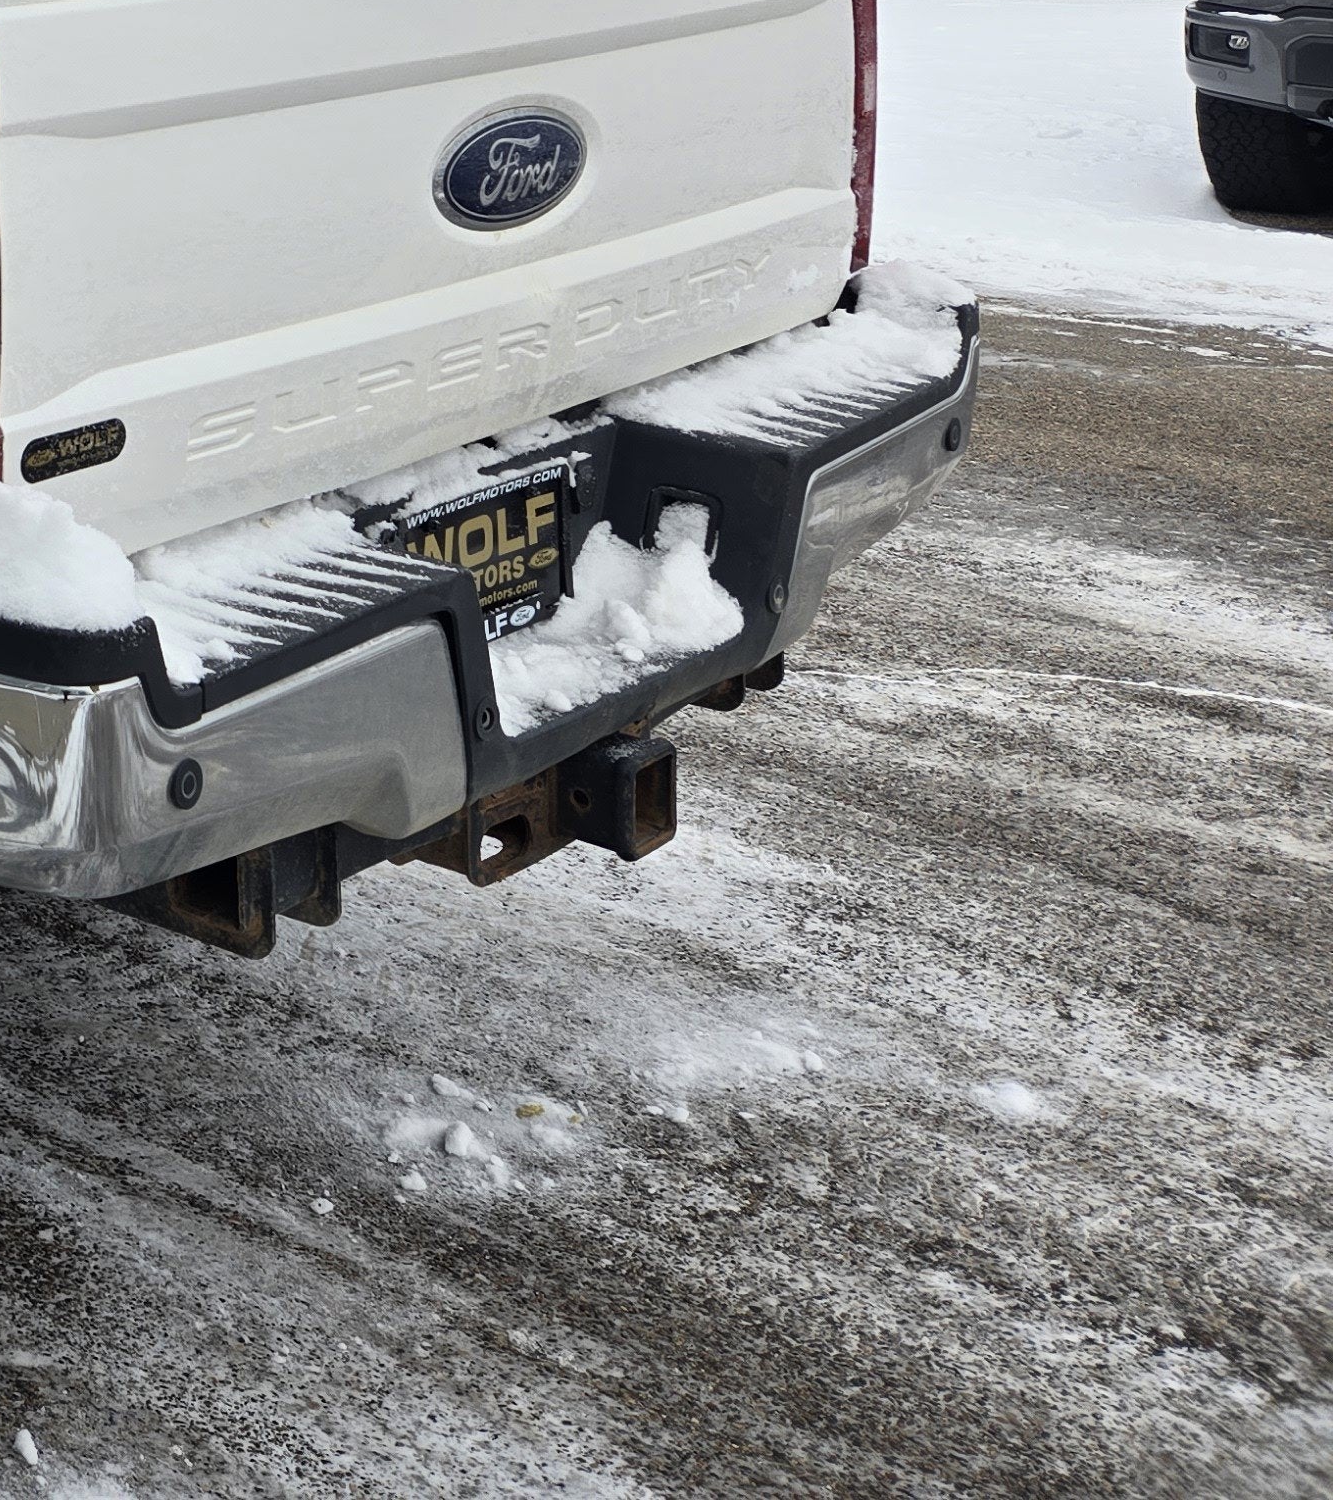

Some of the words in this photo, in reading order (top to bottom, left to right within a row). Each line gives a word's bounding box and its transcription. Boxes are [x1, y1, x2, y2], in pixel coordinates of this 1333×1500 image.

[479, 133, 561, 206] Ford
[186, 321, 550, 461] SUPER
[573, 249, 772, 347] DUTY
[58, 424, 119, 457] WOLF
[473, 555, 525, 591] TORS
[479, 578, 538, 607] motors.com
[484, 611, 508, 642] LF
